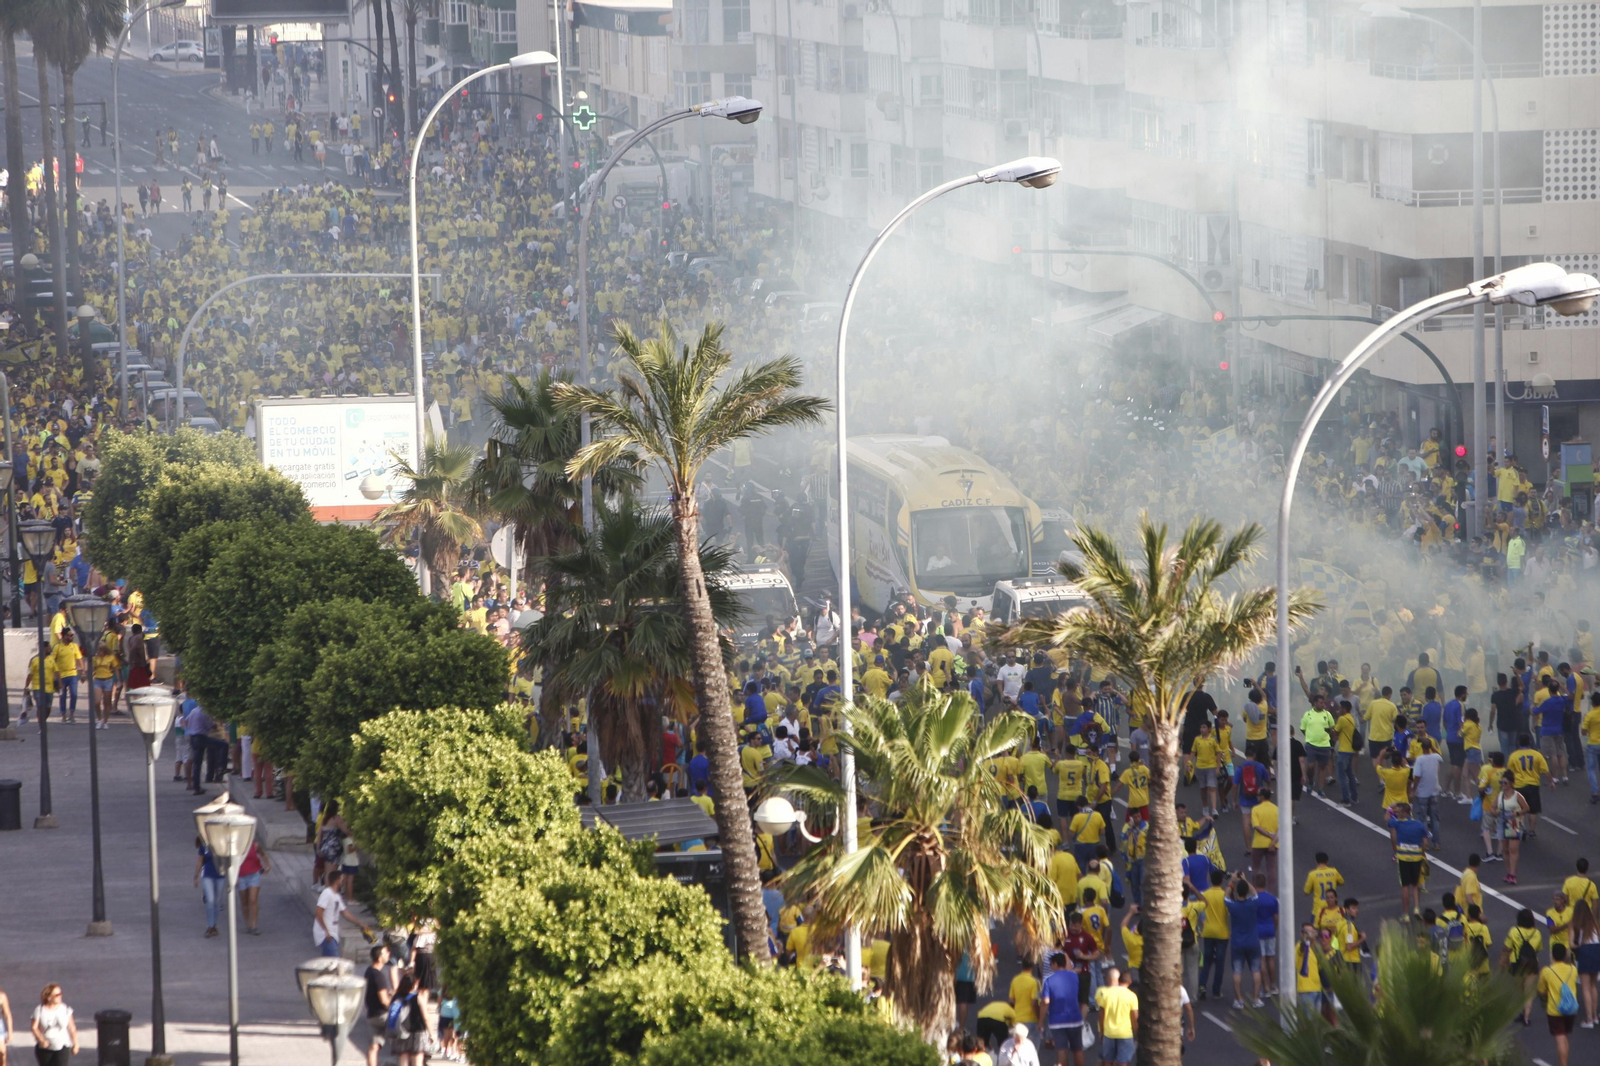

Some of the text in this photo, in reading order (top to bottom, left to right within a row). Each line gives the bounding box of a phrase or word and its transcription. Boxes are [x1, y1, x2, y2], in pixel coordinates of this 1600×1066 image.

[269, 417, 297, 426] TODO
[269, 425, 336, 436] EL COMERCIO
[269, 436, 336, 447] DE TU CIUDAD
[270, 445, 336, 458] EN TU MÓVIL
[313, 463, 336, 472] gratis
[303, 480, 337, 489] comercio
[941, 497, 994, 508] CADIZ C.F.
[1066, 771, 1076, 786] 5
[1133, 775, 1147, 789] 12
[1090, 914, 1100, 930] 8
